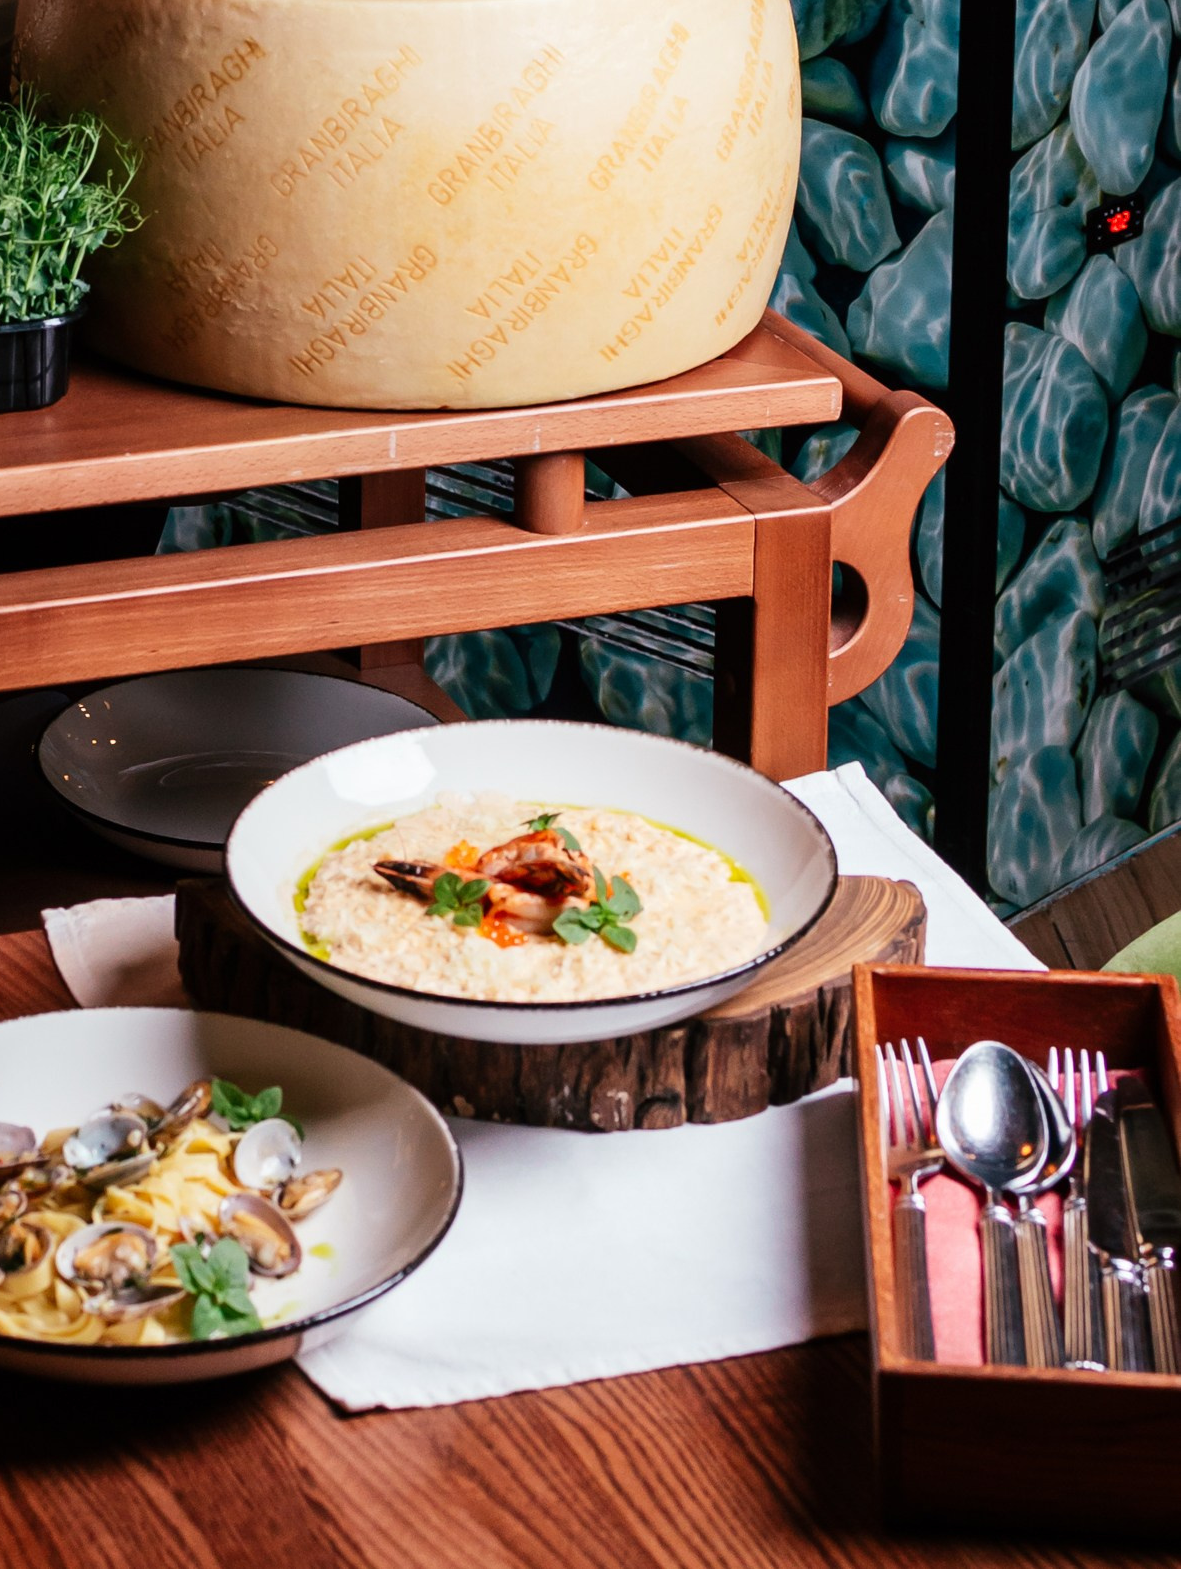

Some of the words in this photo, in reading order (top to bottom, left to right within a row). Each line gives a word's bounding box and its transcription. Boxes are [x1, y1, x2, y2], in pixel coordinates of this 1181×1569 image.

[175, 104, 247, 173] ITALIA
[270, 43, 422, 198] GRANBIRAGHI
[427, 43, 565, 207] GRANBIRAGHI
[588, 20, 691, 193] GRANBIRAGHI
[637, 95, 690, 173] ITALIA
[327, 116, 406, 189] ITALIA
[486, 117, 556, 192] ITALIA
[301, 255, 378, 320] ITALIA
[464, 251, 543, 320] ITALIA
[598, 203, 723, 363] GRANBIRAGHI
[622, 227, 683, 299] ITALIA
[288, 243, 438, 377] GRANBIRAGHI
[446, 232, 599, 381] GRANBIRAGHI
